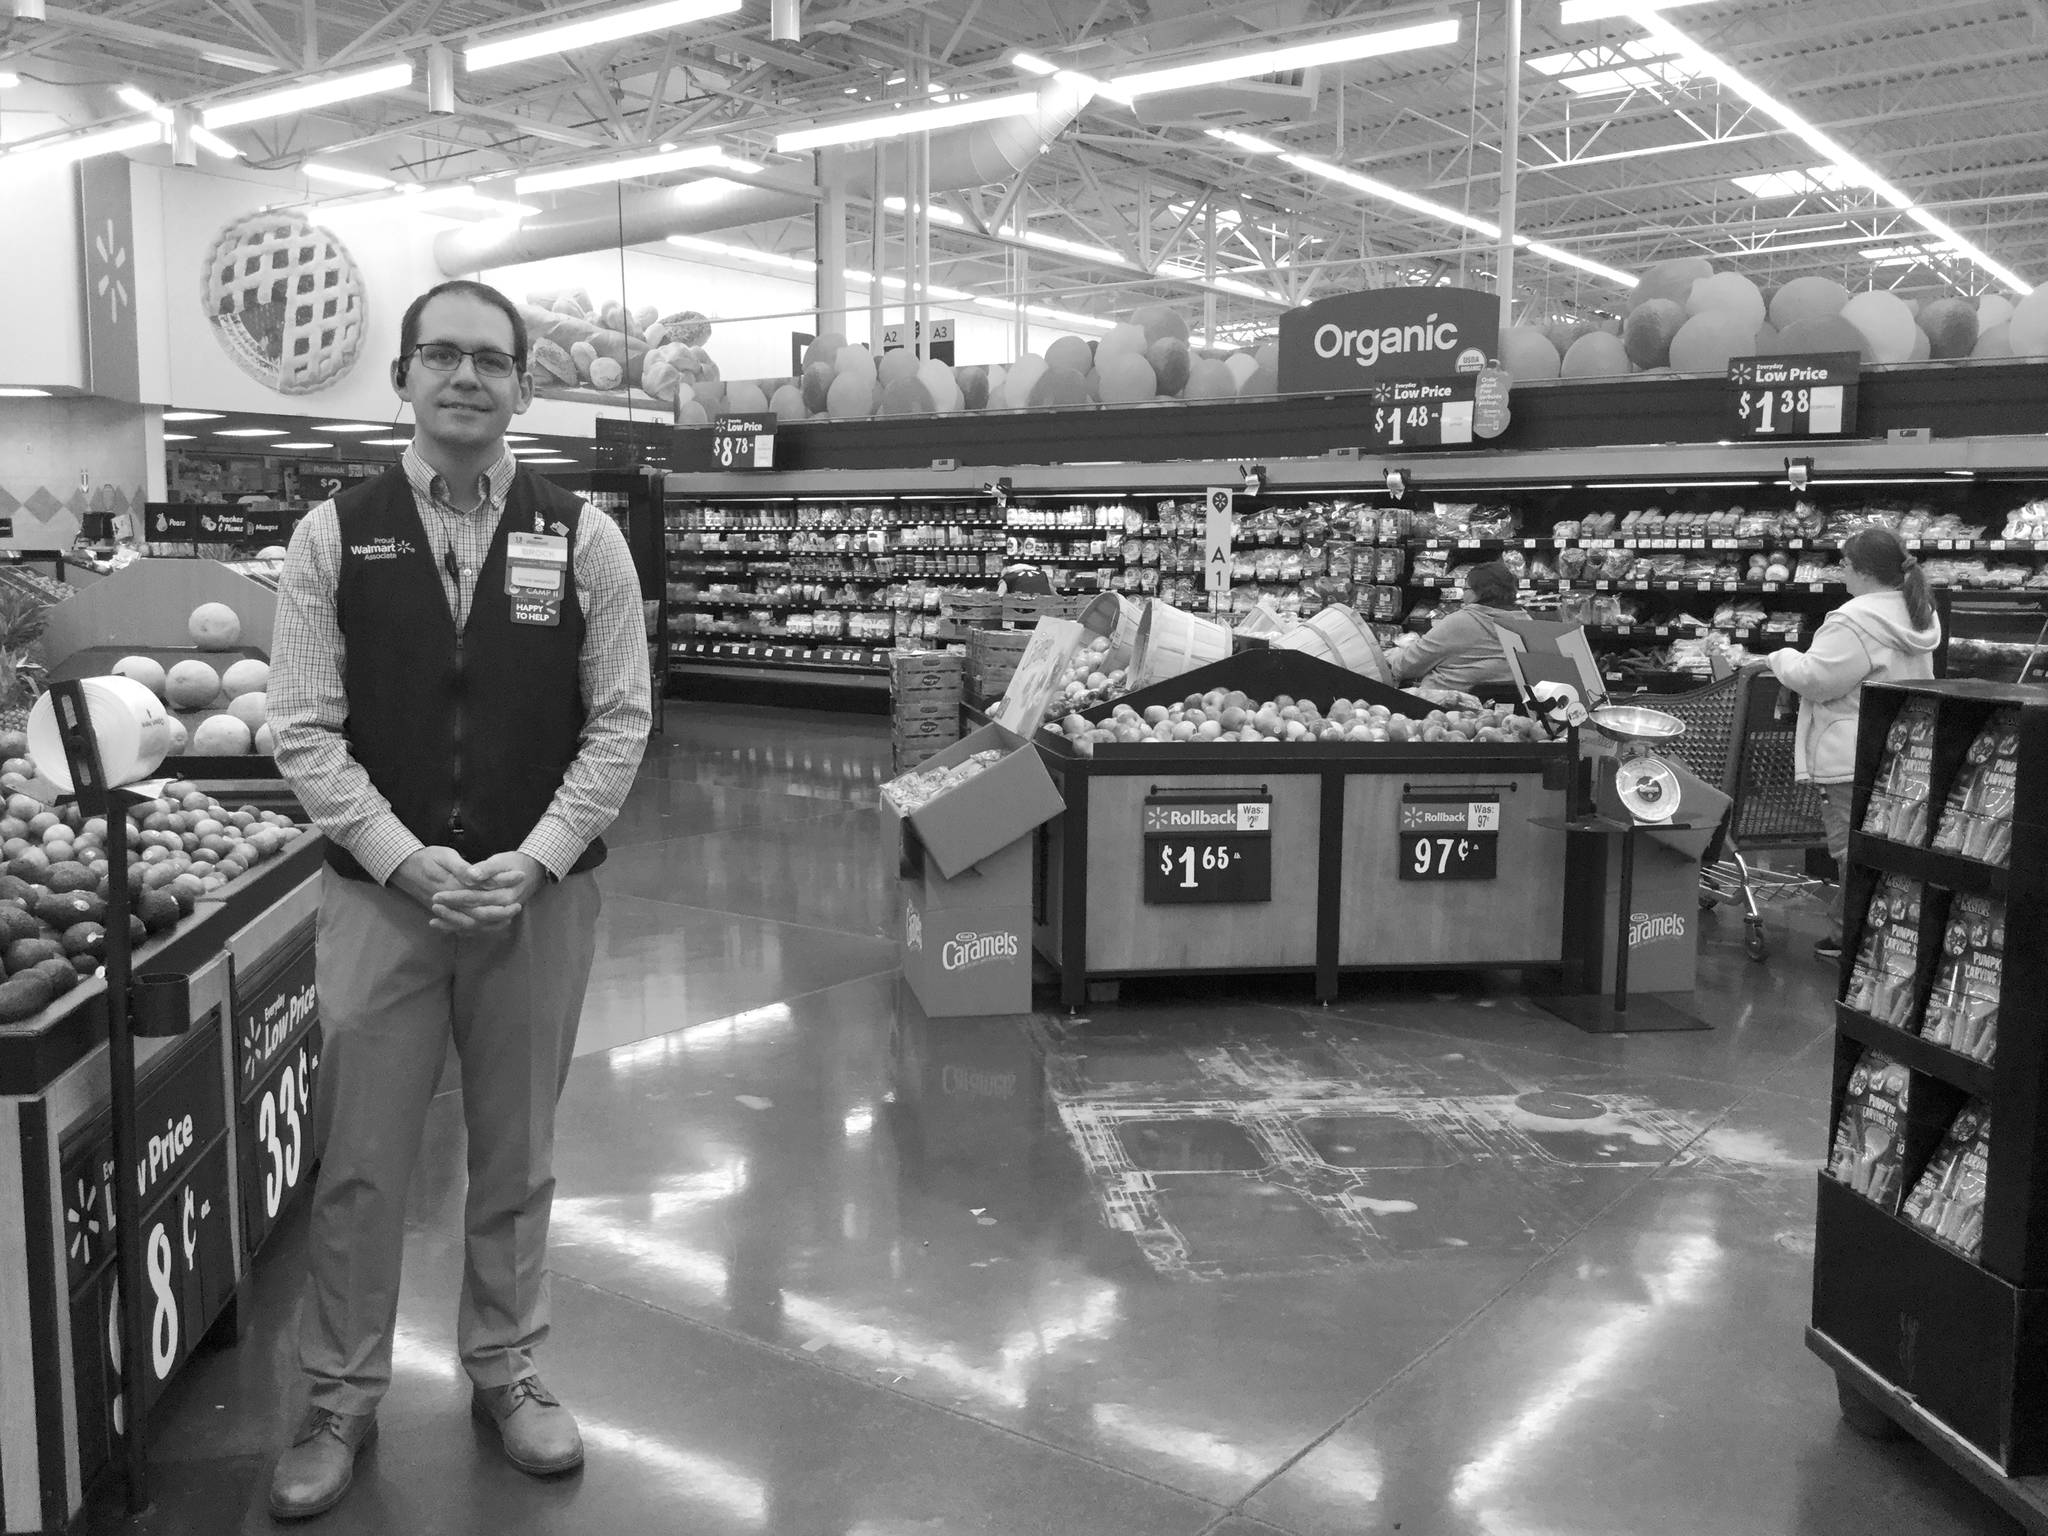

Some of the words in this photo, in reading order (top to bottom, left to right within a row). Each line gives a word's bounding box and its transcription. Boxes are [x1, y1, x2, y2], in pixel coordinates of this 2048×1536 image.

[883, 331, 897, 343] A2
[933, 326, 948, 339] A3
[1314, 313, 1458, 367] Organic
[1756, 369, 1787, 383] Low
[1789, 366, 1828, 382] Price
[1394, 388, 1419, 401] Low
[1421, 385, 1452, 399] Price
[727, 422, 744, 432] Low
[743, 421, 763, 432] Price
[168, 518, 186, 527] Pears
[374, 536, 396, 544] Proud
[350, 543, 396, 555] Walmart
[364, 552, 397, 560] Associate
[1210, 545, 1226, 564] A
[1215, 570, 1221, 587] 1
[526, 587, 551, 596] CAMP
[516, 603, 544, 612] HAPPY
[516, 611, 528, 620] TO
[528, 612, 550, 621] HELP
[1170, 809, 1237, 825] Rollback
[1424, 811, 1466, 822] Rollback
[1628, 912, 1686, 946] aramels
[942, 931, 1018, 971] Caramels
[264, 993, 286, 1022] Everyday
[264, 1010, 289, 1061] Low
[288, 983, 316, 1033] Price
[148, 1113, 194, 1186] Price
